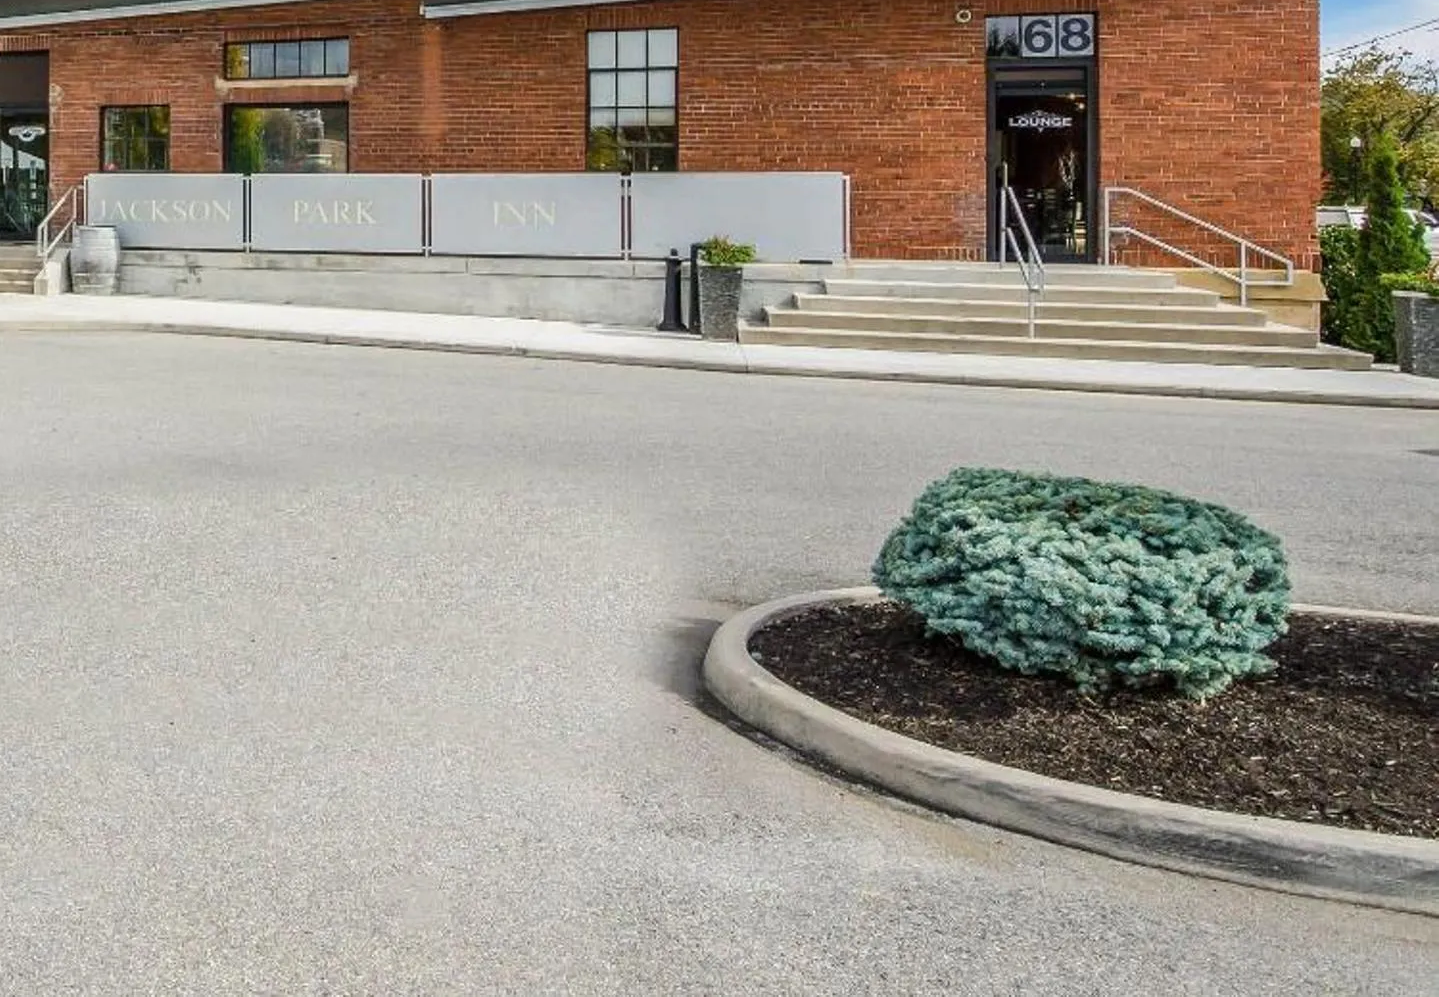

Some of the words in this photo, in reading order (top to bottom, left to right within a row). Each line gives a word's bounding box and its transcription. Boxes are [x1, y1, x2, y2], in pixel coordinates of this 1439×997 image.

[1024, 17, 1091, 54] 68
[1008, 117, 1072, 127] LOUNGE
[92, 199, 232, 223] JACKSON
[293, 199, 377, 225] PARK
[492, 201, 557, 228] INN
